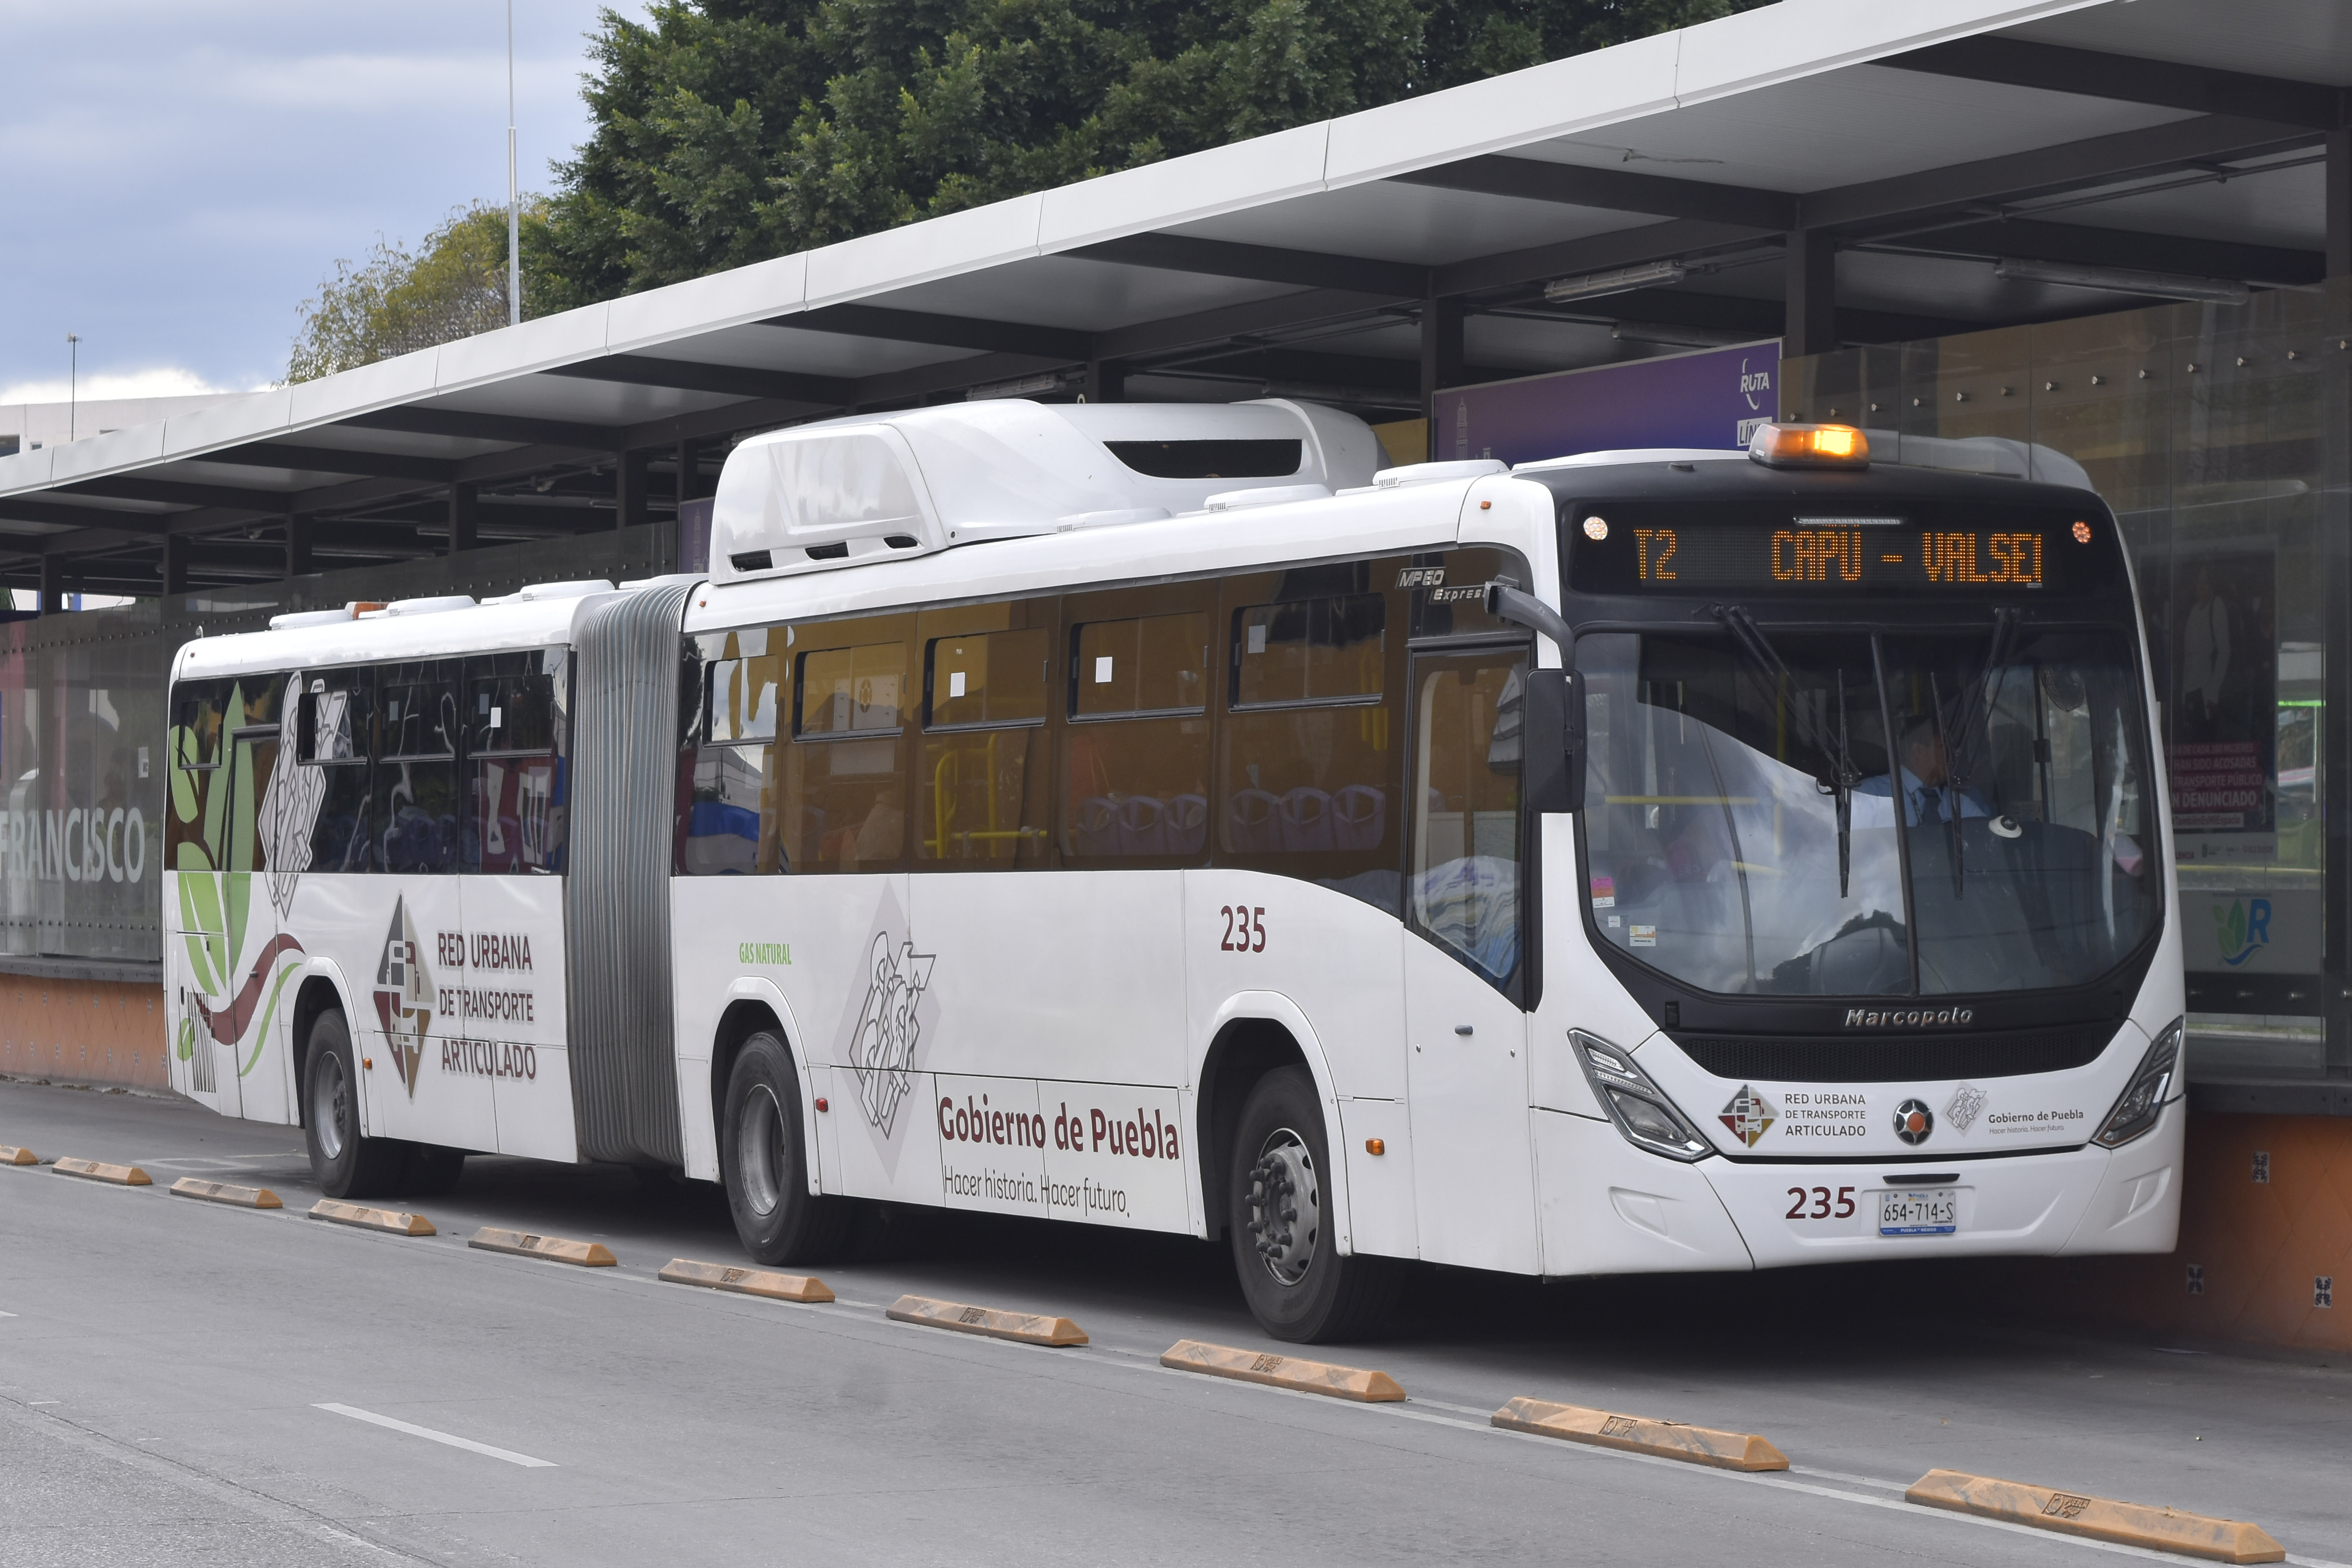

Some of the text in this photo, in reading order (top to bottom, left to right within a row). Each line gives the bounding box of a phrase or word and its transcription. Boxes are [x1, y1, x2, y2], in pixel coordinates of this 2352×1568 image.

[1740, 372, 1769, 392] RUTA
[1633, 529, 1677, 579] T2
[1772, 531, 1861, 581] CAPU
[1399, 570, 1444, 587] MP60
[1434, 589, 1485, 602] Expres
[2193, 758, 2212, 770] SIDO
[2213, 757, 2256, 769] ACOSADAS
[2174, 772, 2262, 787] TRANSPORTE PÚBLICO
[2183, 790, 2257, 807] DENUNCIADO
[0, 807, 144, 883] FRANCISCO
[1221, 905, 1266, 953] 235
[438, 933, 533, 970] RED URBANA
[739, 943, 792, 965] GAS NATURAL
[440, 989, 534, 1021] DE TRANSPORTE
[1845, 1007, 1973, 1027] Marcopolo
[442, 1039, 536, 1080] ARTICULADO
[1785, 1094, 1866, 1105] RED URBANA
[1785, 1110, 1866, 1119] DE TRANSPORTE
[1989, 1109, 2084, 1123] Gobierno de Puebla
[939, 1093, 1179, 1160] Gobierno de Puebla
[1785, 1125, 1866, 1136] ARTICULADO
[945, 1165, 1130, 1218] Hacer historia. Hacer futuro.
[1786, 1186, 1855, 1219] 235
[1884, 1202, 1953, 1221] 654-714-S
